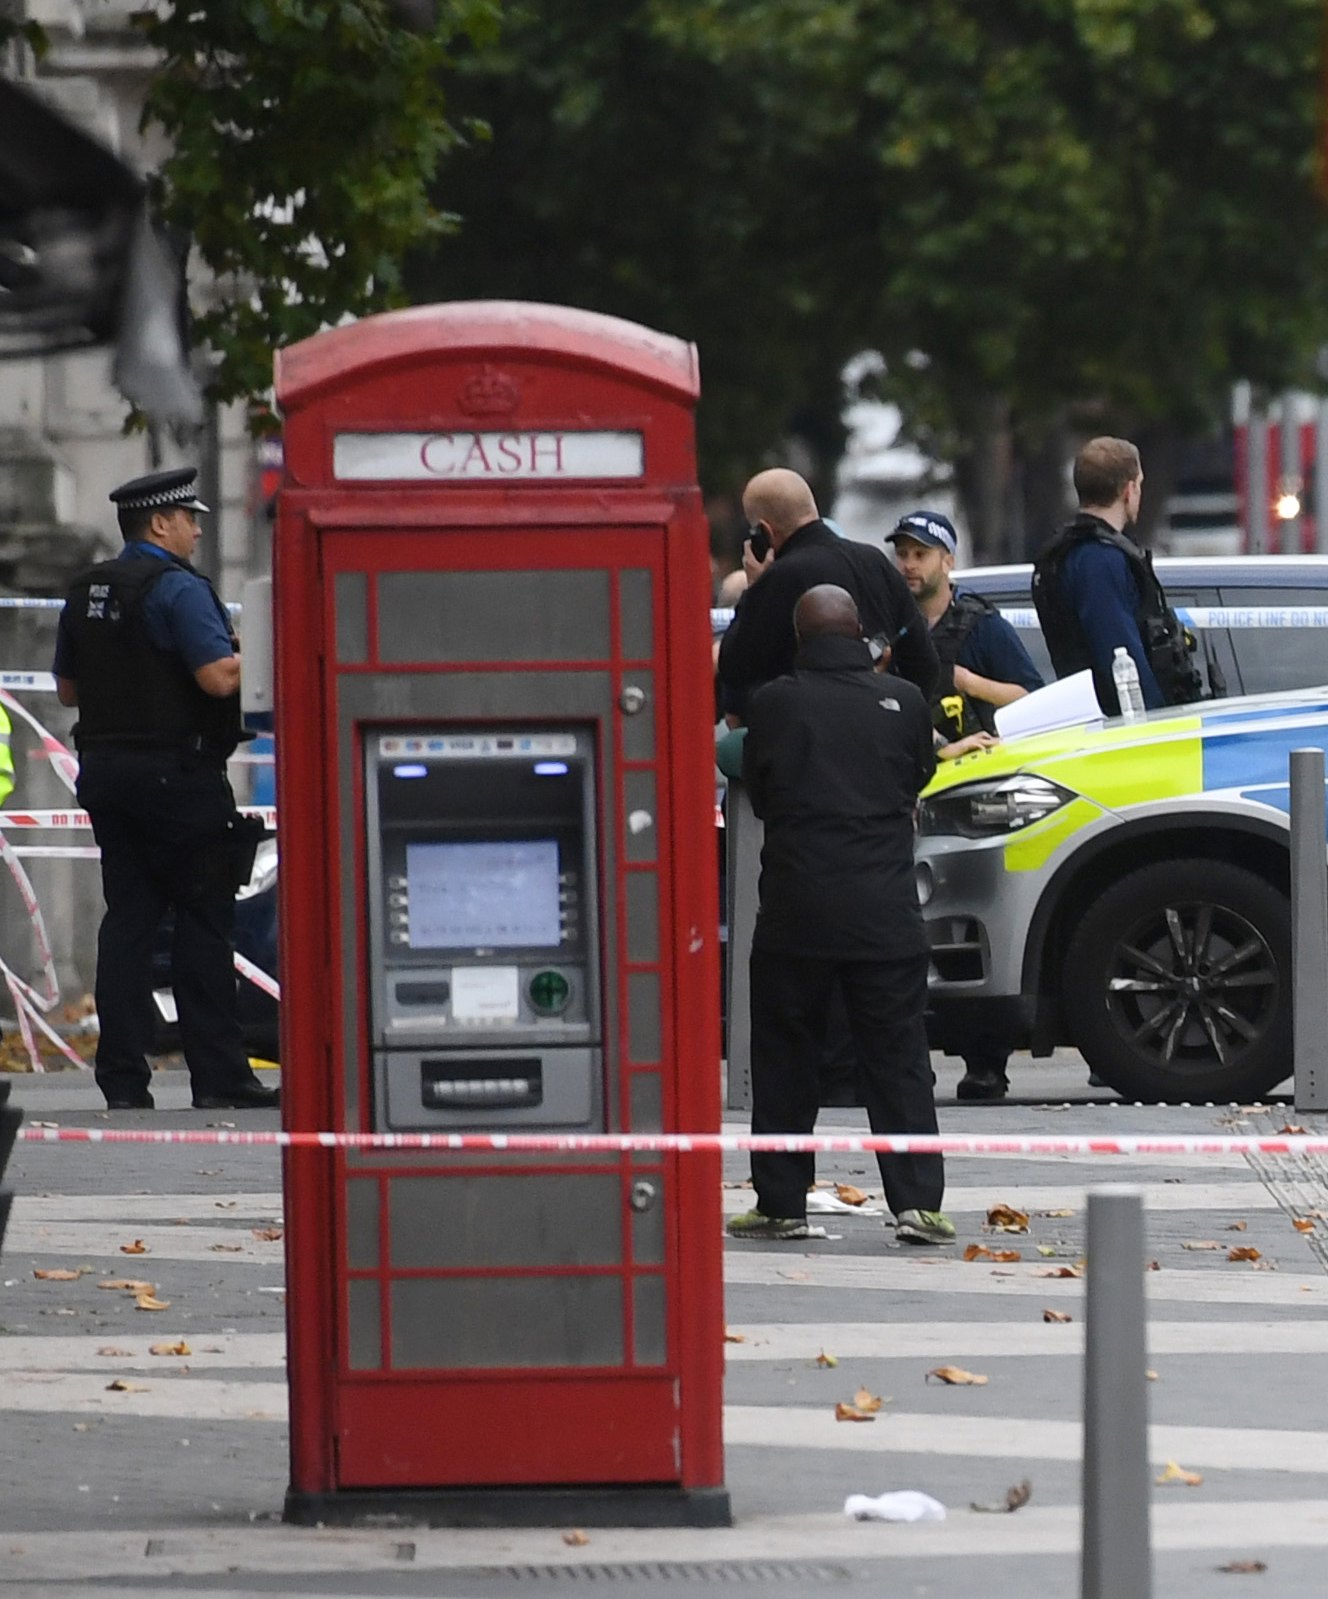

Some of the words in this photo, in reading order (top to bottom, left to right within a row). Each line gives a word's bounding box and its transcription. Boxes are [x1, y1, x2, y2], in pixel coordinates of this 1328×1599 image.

[420, 432, 564, 474] CASH
[1208, 611, 1254, 627] POLICE
[1258, 611, 1287, 627] LINE
[1290, 611, 1310, 626] DO
